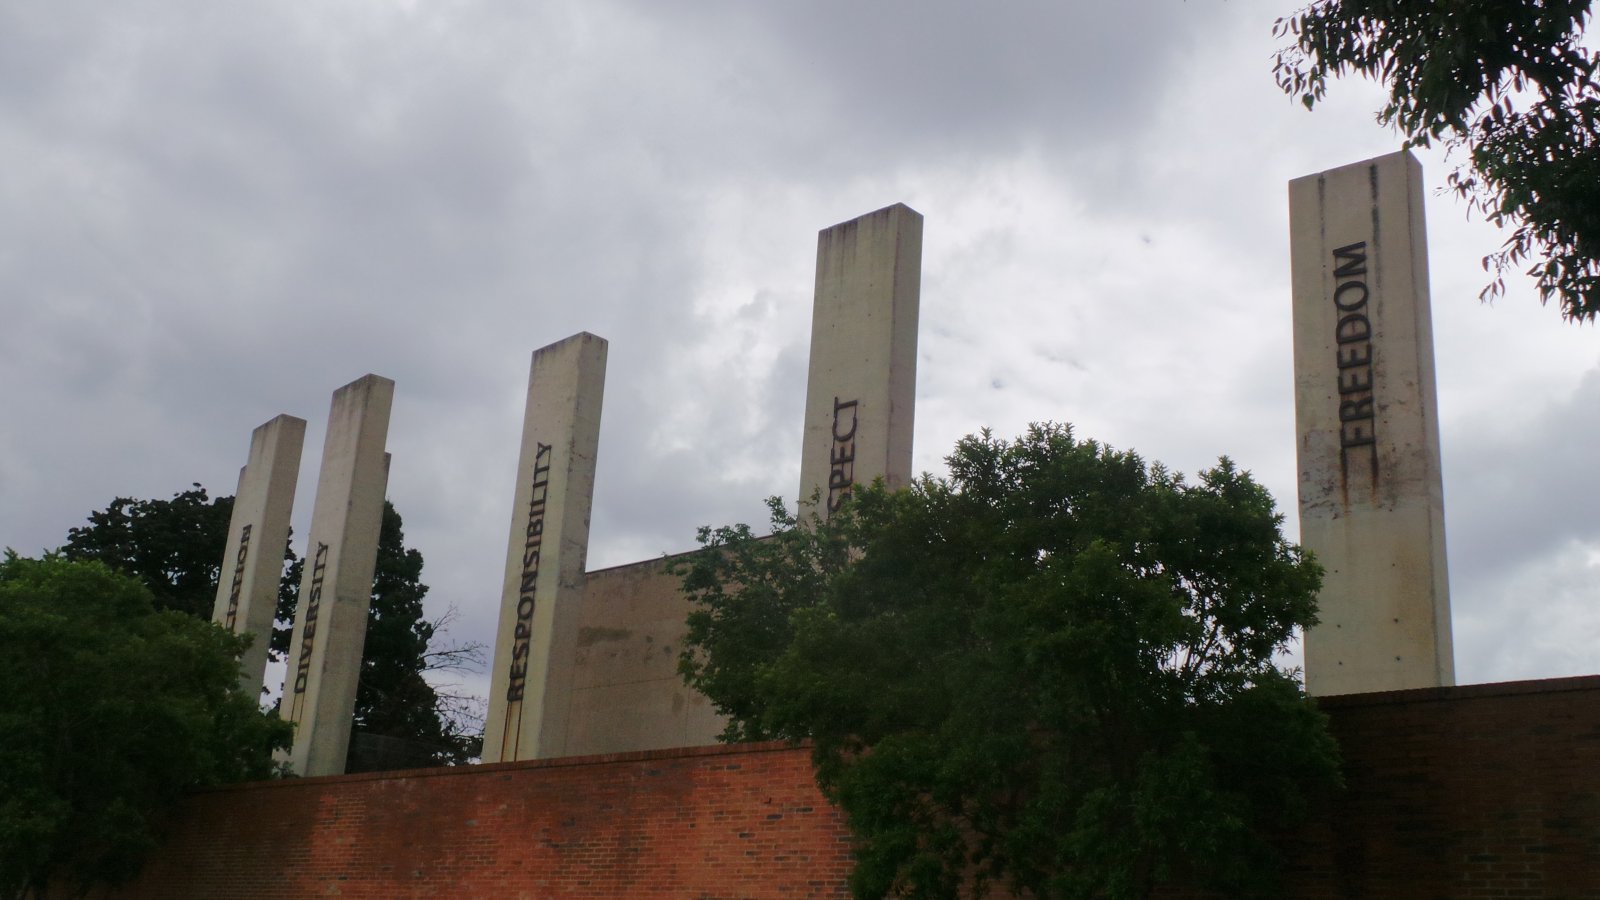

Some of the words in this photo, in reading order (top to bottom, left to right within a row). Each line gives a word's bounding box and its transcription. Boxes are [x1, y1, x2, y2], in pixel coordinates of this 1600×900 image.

[1333, 241, 1376, 448] FREEDOM
[294, 541, 328, 694] DIVERSITY
[507, 442, 552, 702] RESPONSIBILITY
